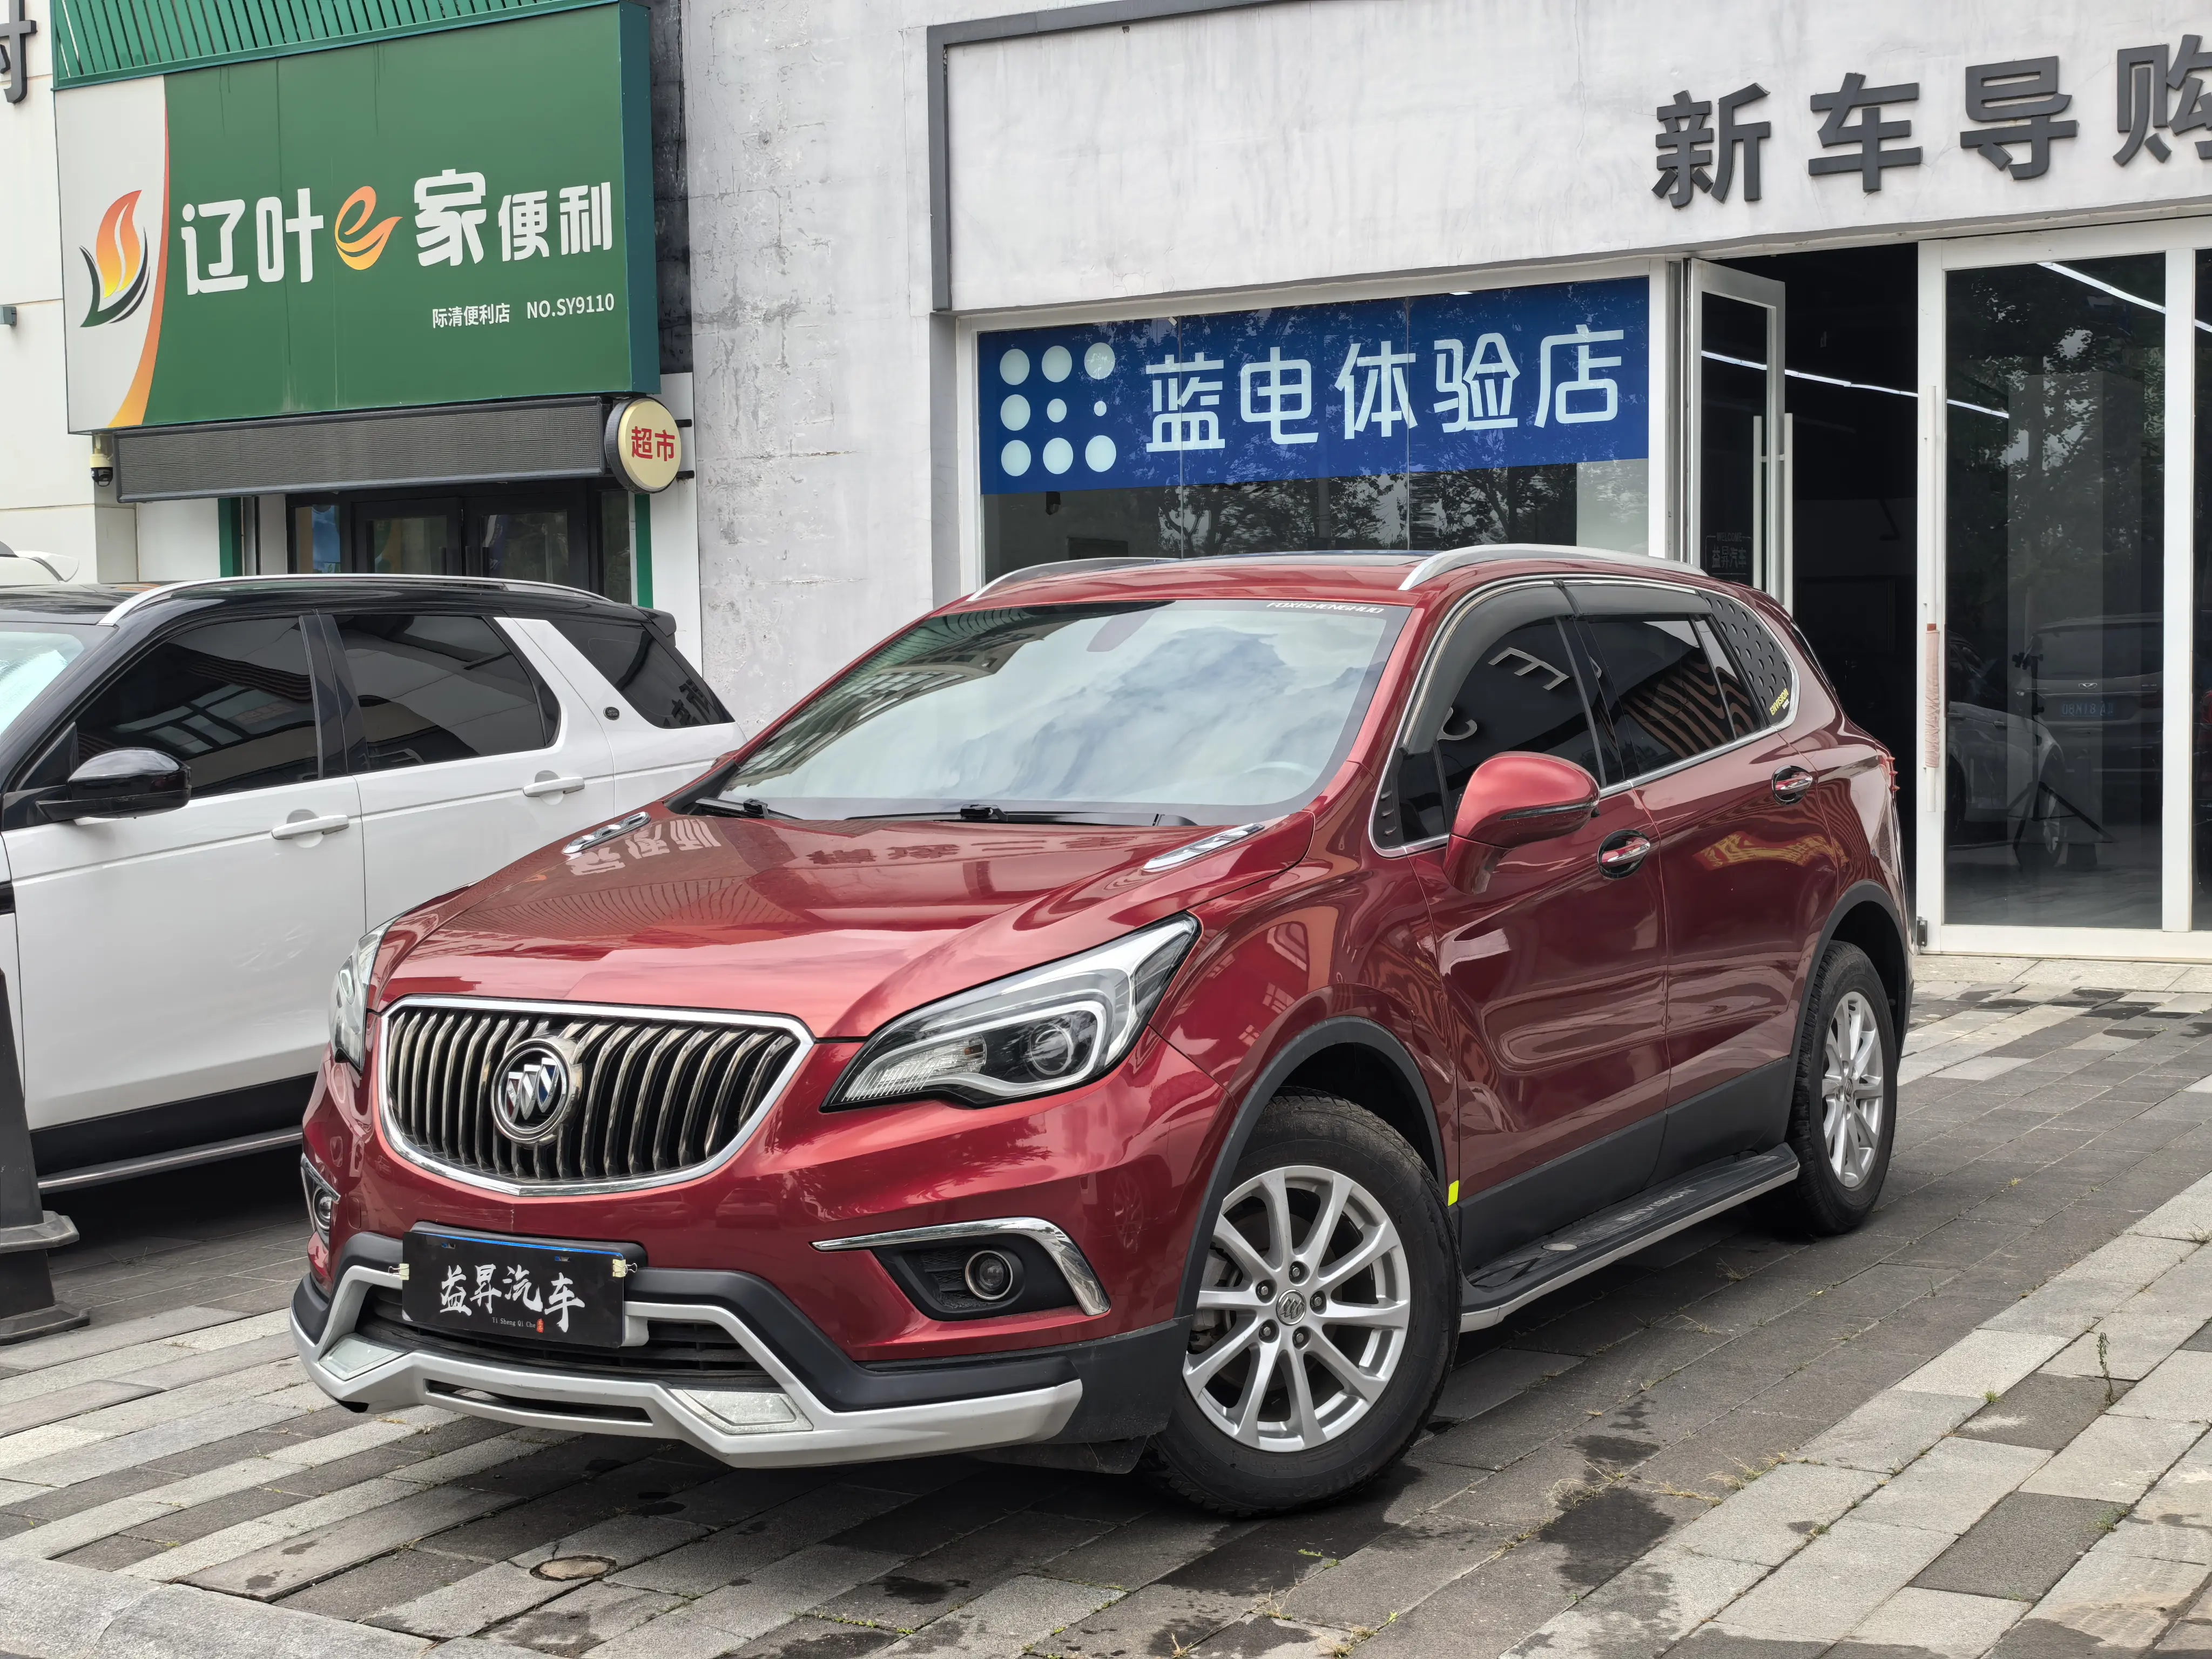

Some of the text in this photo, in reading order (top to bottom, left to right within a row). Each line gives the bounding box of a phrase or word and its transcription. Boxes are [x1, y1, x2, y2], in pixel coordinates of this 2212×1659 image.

[1652, 33, 2212, 209] 新车导购
[433, 293, 615, 328] 际清便利店 NO.SY9110
[1145, 324, 1624, 453] 蓝电体验店
[631, 426, 675, 462] 超市
[1615, 1189, 1697, 1222] ENVISION
[500, 1318, 516, 1327] Sheng
